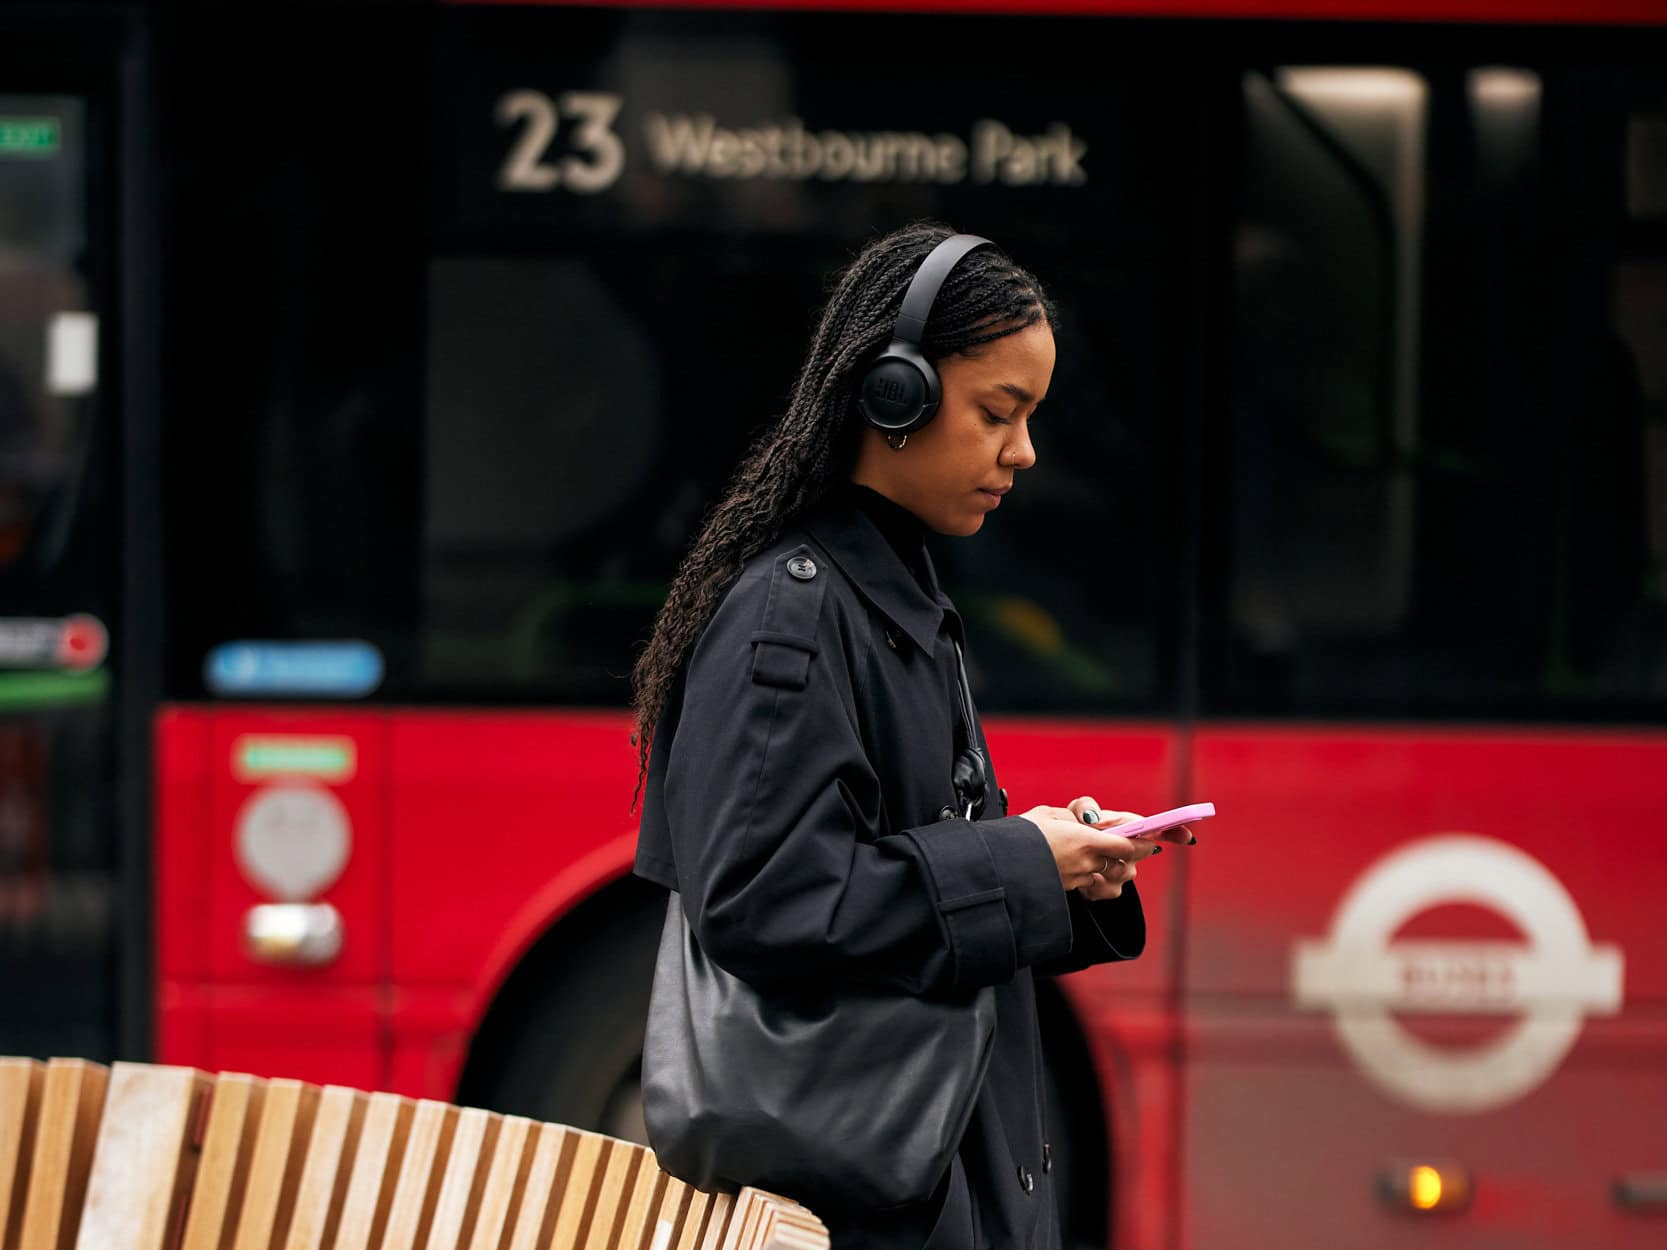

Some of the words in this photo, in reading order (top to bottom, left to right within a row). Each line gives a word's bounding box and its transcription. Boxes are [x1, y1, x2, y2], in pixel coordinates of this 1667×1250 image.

[503, 93, 625, 190] 23
[647, 115, 962, 179] Westbourne
[980, 124, 1083, 183] Park
